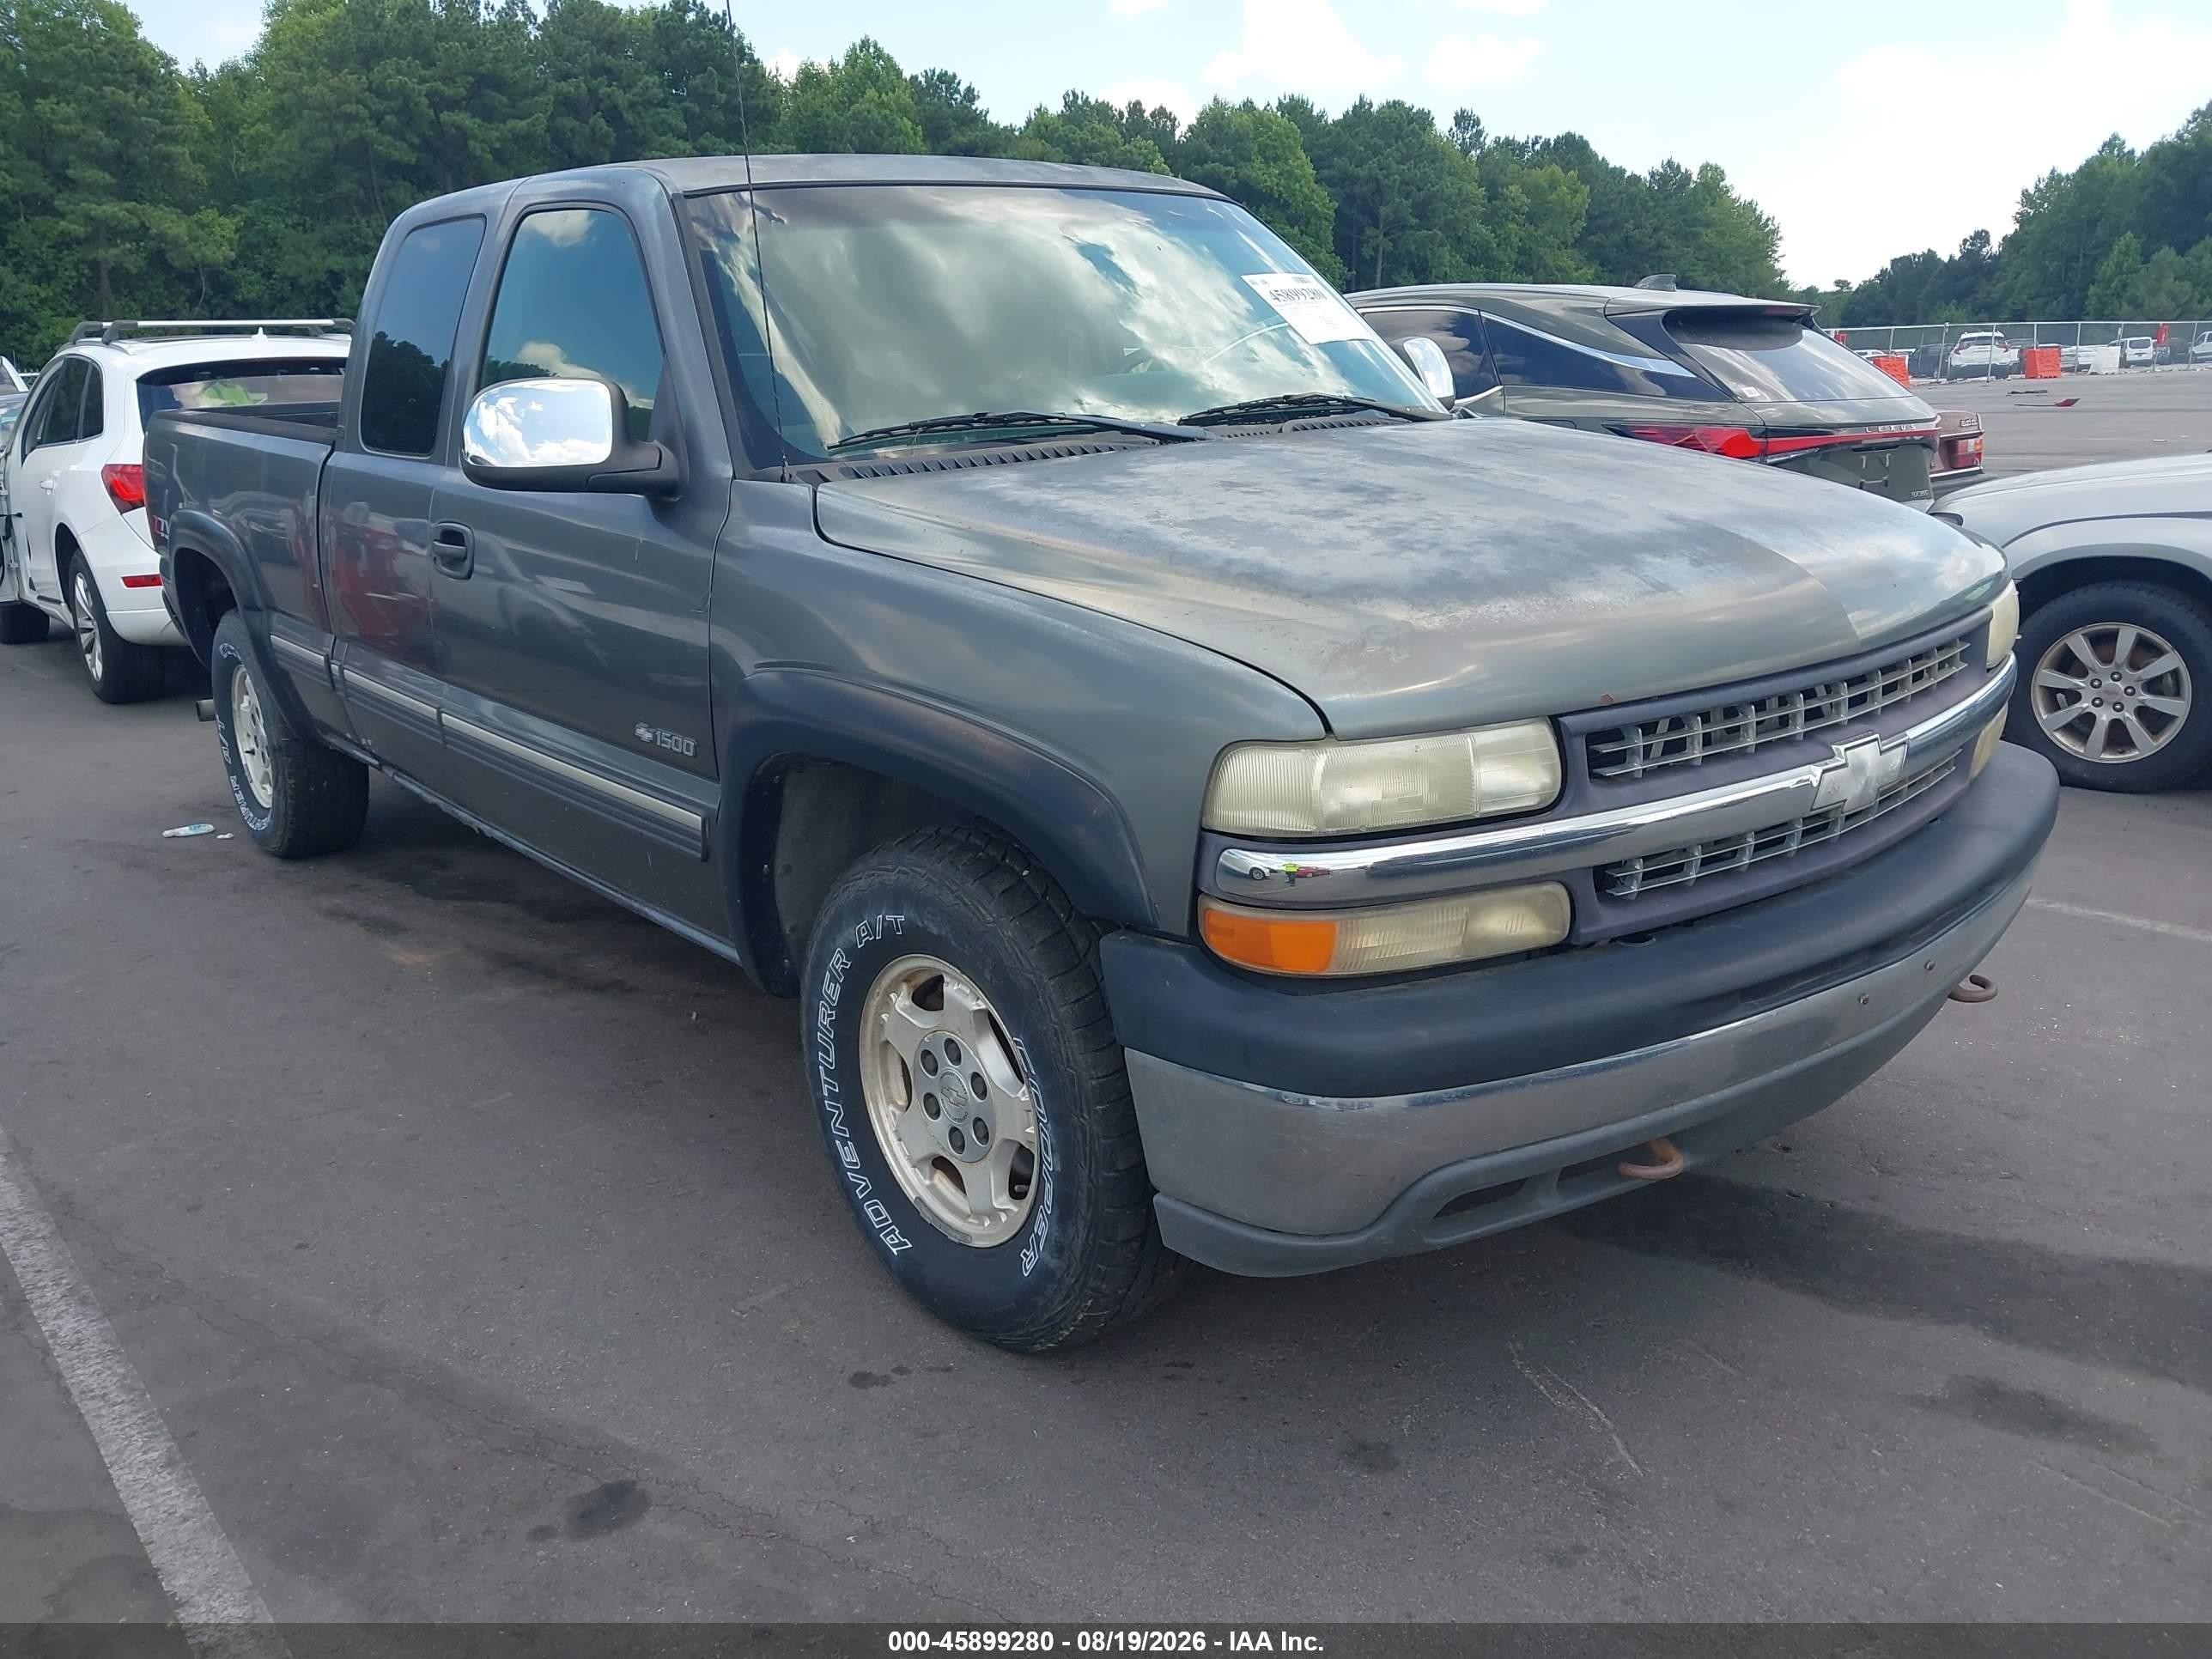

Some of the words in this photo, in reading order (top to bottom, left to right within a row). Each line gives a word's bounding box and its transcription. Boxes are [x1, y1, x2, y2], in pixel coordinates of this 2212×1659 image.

[1269, 288, 1328, 302] 45899280
[1865, 424, 1917, 433] LEXUS
[655, 730, 696, 757] 1500
[855, 915, 906, 949] A/T
[817, 947, 913, 1257] ADVENTURER
[1012, 1037, 1054, 1277] COOPER
